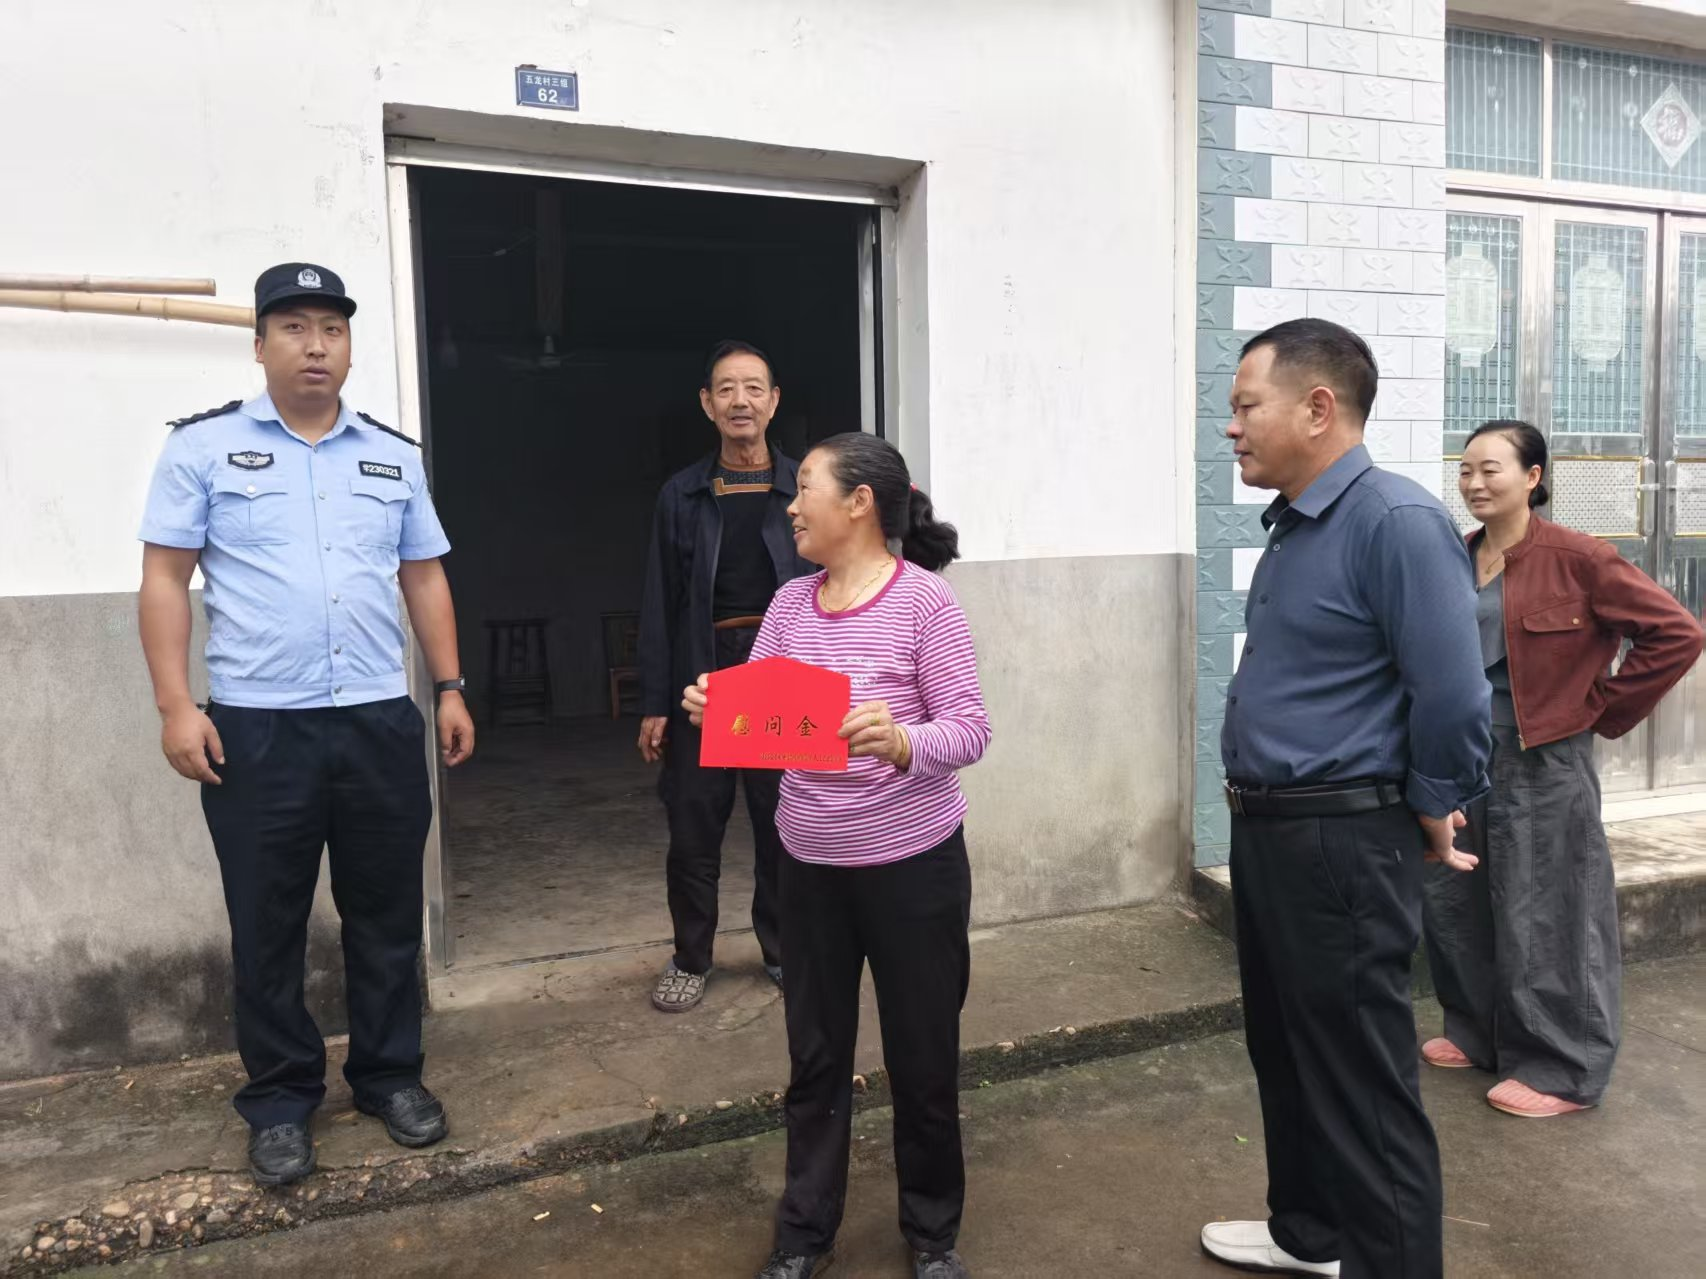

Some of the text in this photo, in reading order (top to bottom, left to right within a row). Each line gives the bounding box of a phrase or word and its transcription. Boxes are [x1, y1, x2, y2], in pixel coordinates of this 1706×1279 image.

[525, 75, 568, 88] 五龙村三组
[538, 88, 558, 103] 62
[731, 714, 818, 737] 慰问金
